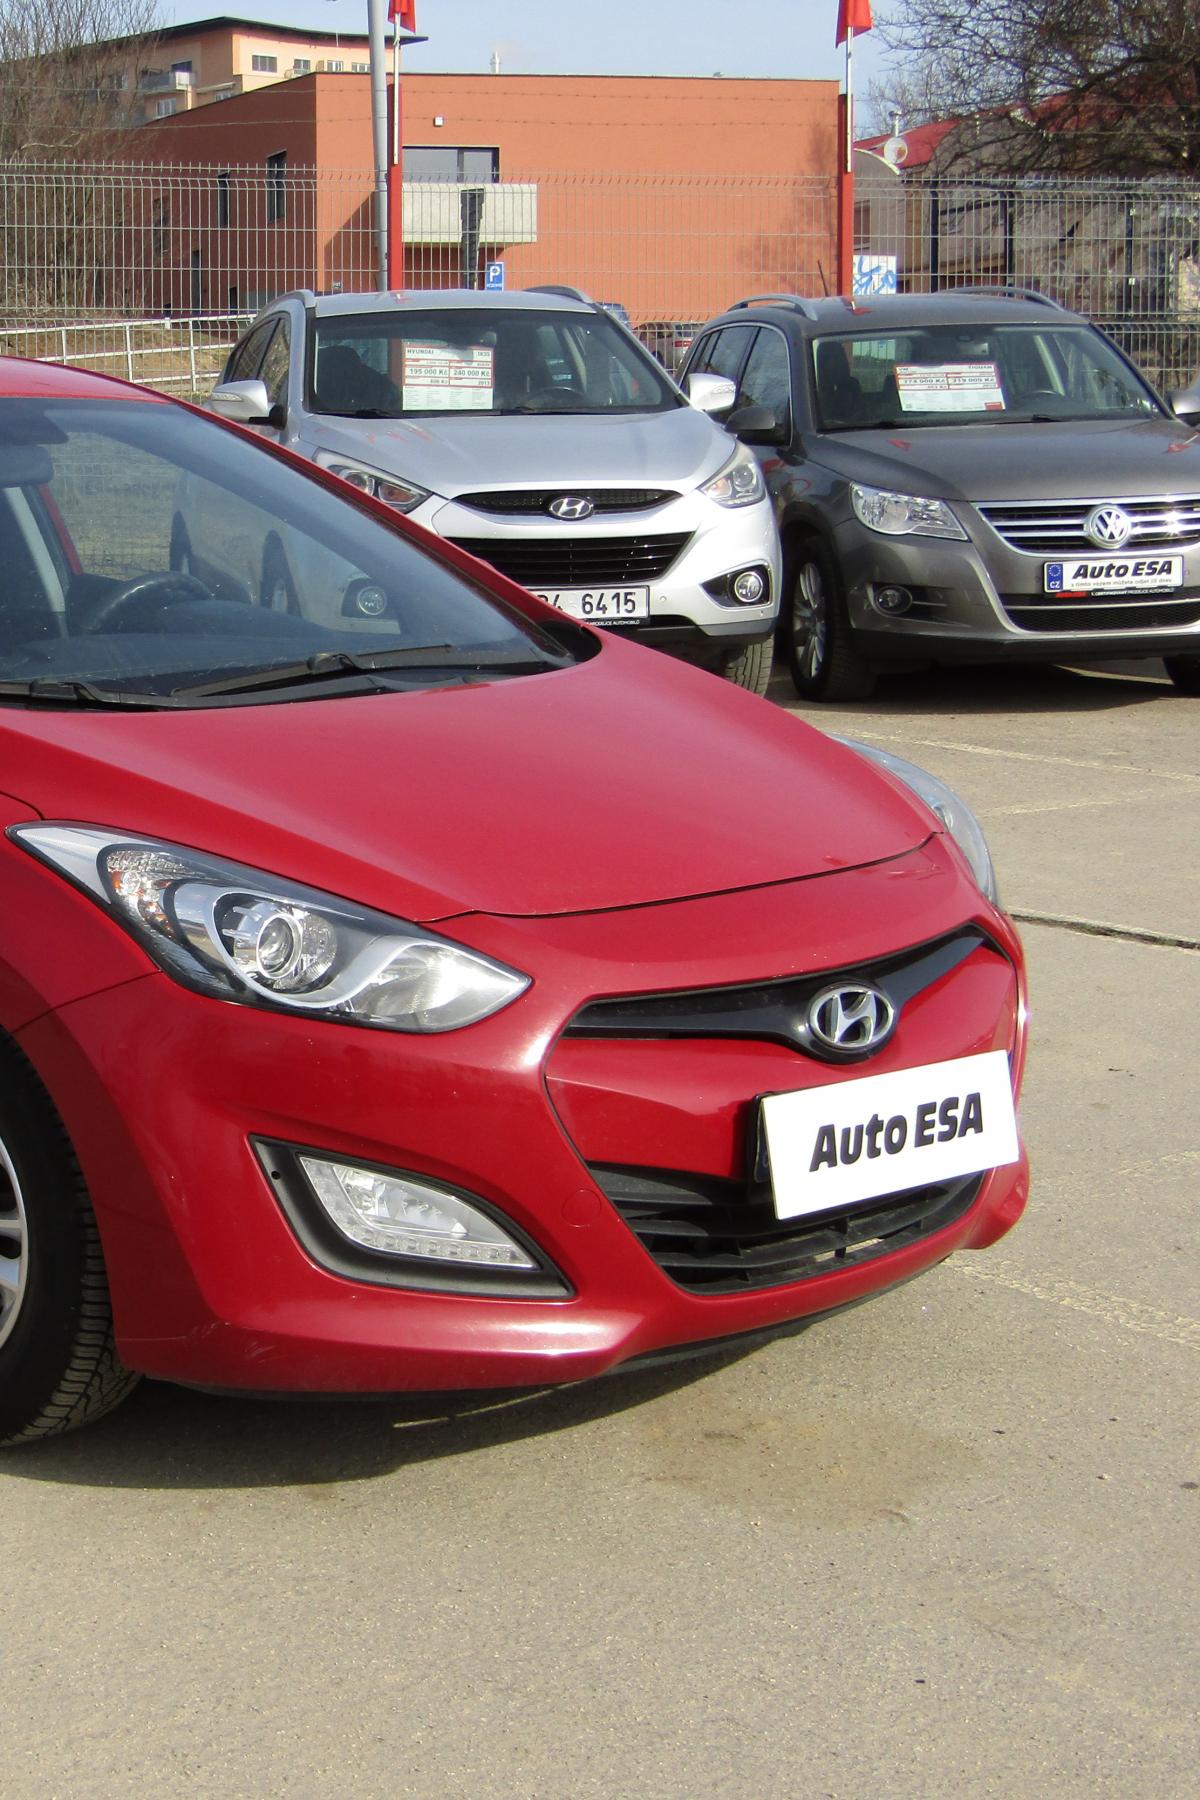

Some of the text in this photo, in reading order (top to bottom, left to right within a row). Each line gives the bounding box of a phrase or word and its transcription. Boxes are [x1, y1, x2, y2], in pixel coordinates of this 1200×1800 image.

[489, 265, 501, 282] P
[1072, 560, 1173, 580] Auto ESA
[1049, 580, 1060, 588] CZ
[581, 592, 636, 615] 6415
[809, 1092, 983, 1173] Auto ESA
